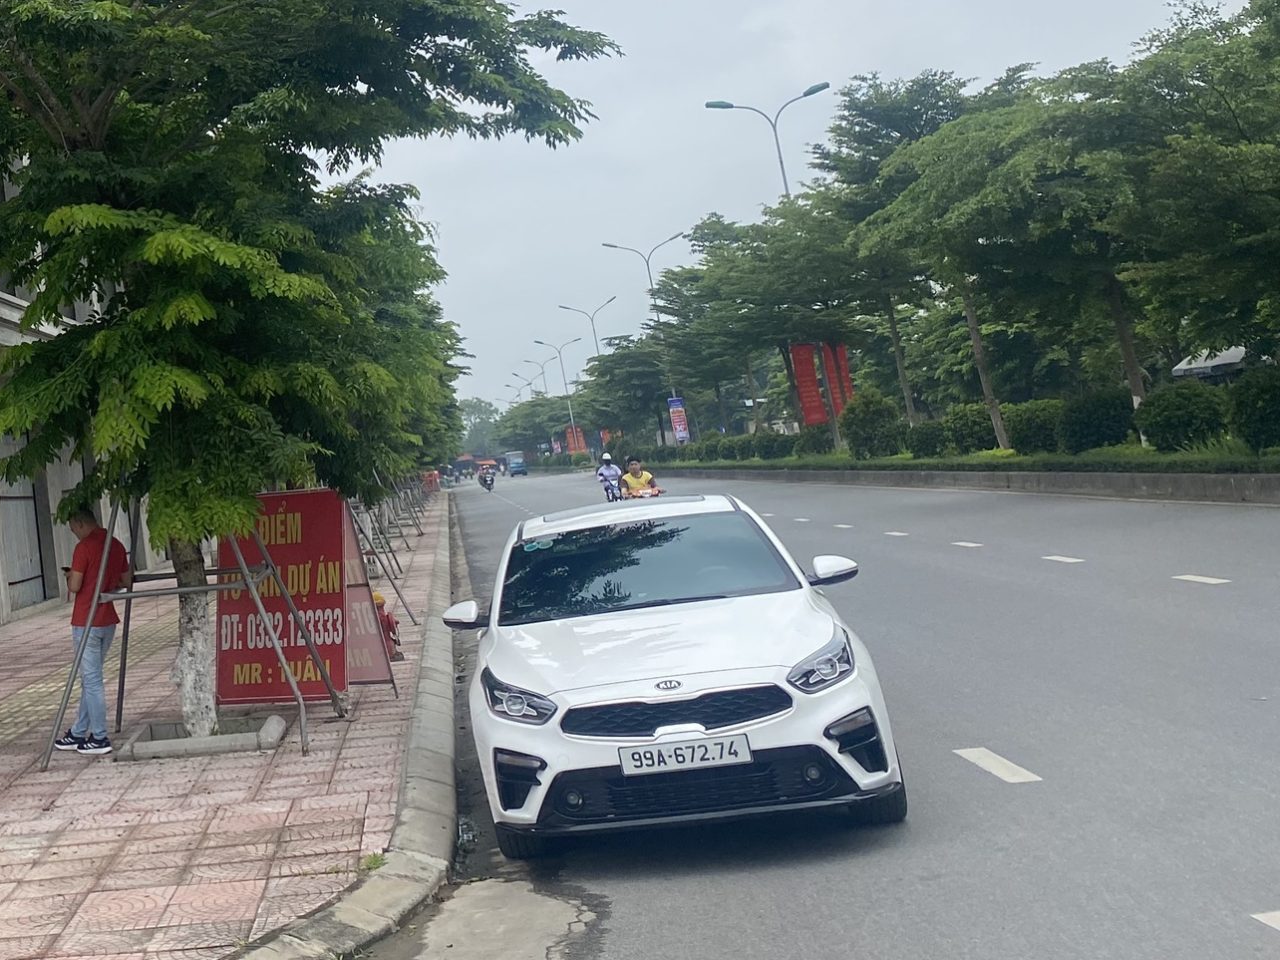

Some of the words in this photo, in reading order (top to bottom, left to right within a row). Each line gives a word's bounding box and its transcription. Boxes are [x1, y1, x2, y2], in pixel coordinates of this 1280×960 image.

[288, 560, 312, 602] DỰ
[316, 555, 341, 594] ÁN
[221, 614, 243, 650] ĐT:
[233, 662, 262, 685] MR
[659, 680, 679, 689] KIA
[631, 741, 739, 769] 99A-672.74
